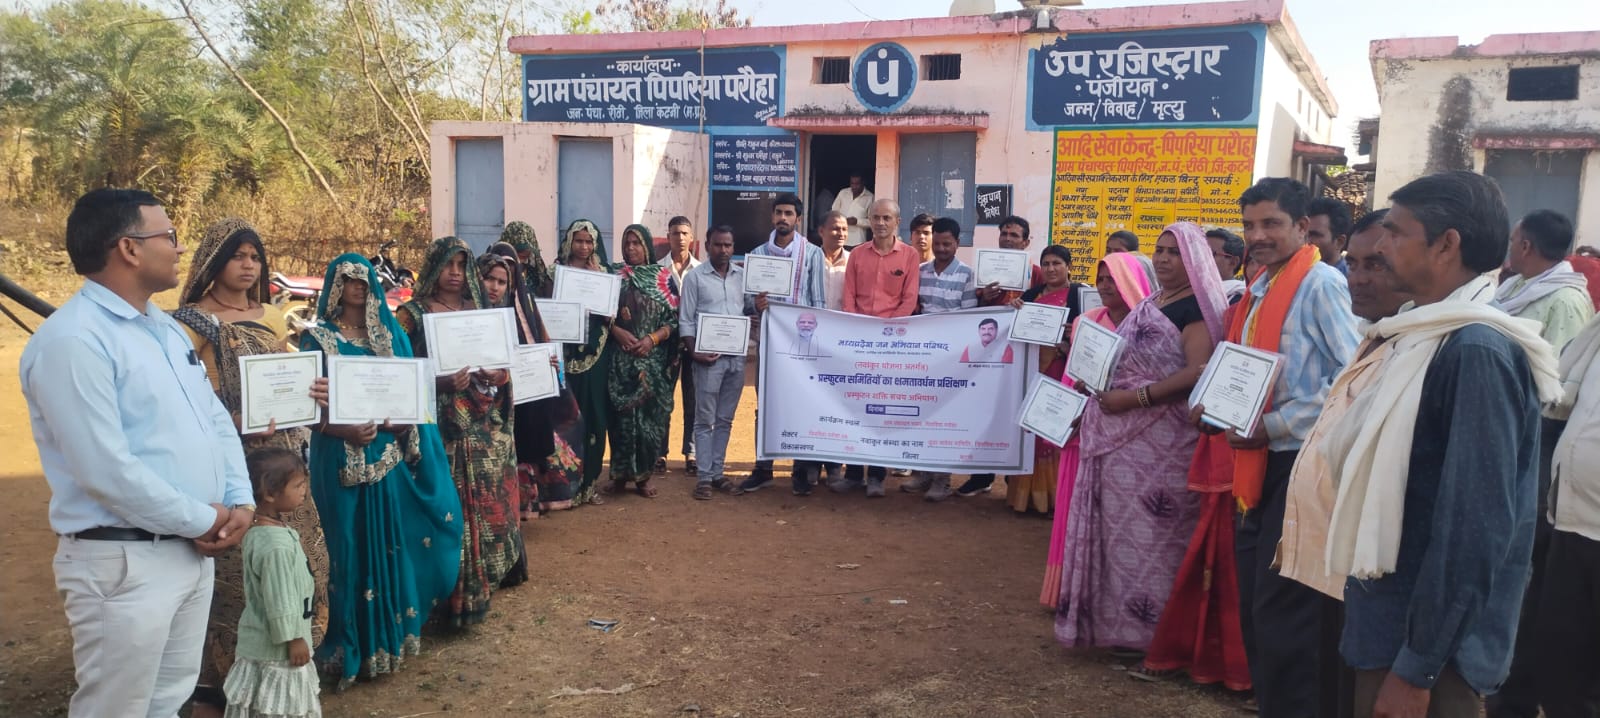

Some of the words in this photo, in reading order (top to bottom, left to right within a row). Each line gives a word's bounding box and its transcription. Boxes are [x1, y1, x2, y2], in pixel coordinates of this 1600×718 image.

[616, 56, 675, 74] कार्यालय
[1045, 50, 1093, 77] उप
[1096, 41, 1229, 80] रजिस्ट्रार
[528, 79, 570, 107] ग्राम
[571, 72, 642, 103] पंचायत
[644, 70, 722, 103] पिपरिया
[722, 65, 778, 105] परौहा
[1085, 74, 1158, 98] पंजीयन
[847, 373, 881, 386] समितियों
[882, 374, 893, 386] का
[937, 376, 968, 389] प्रशिक्षण
